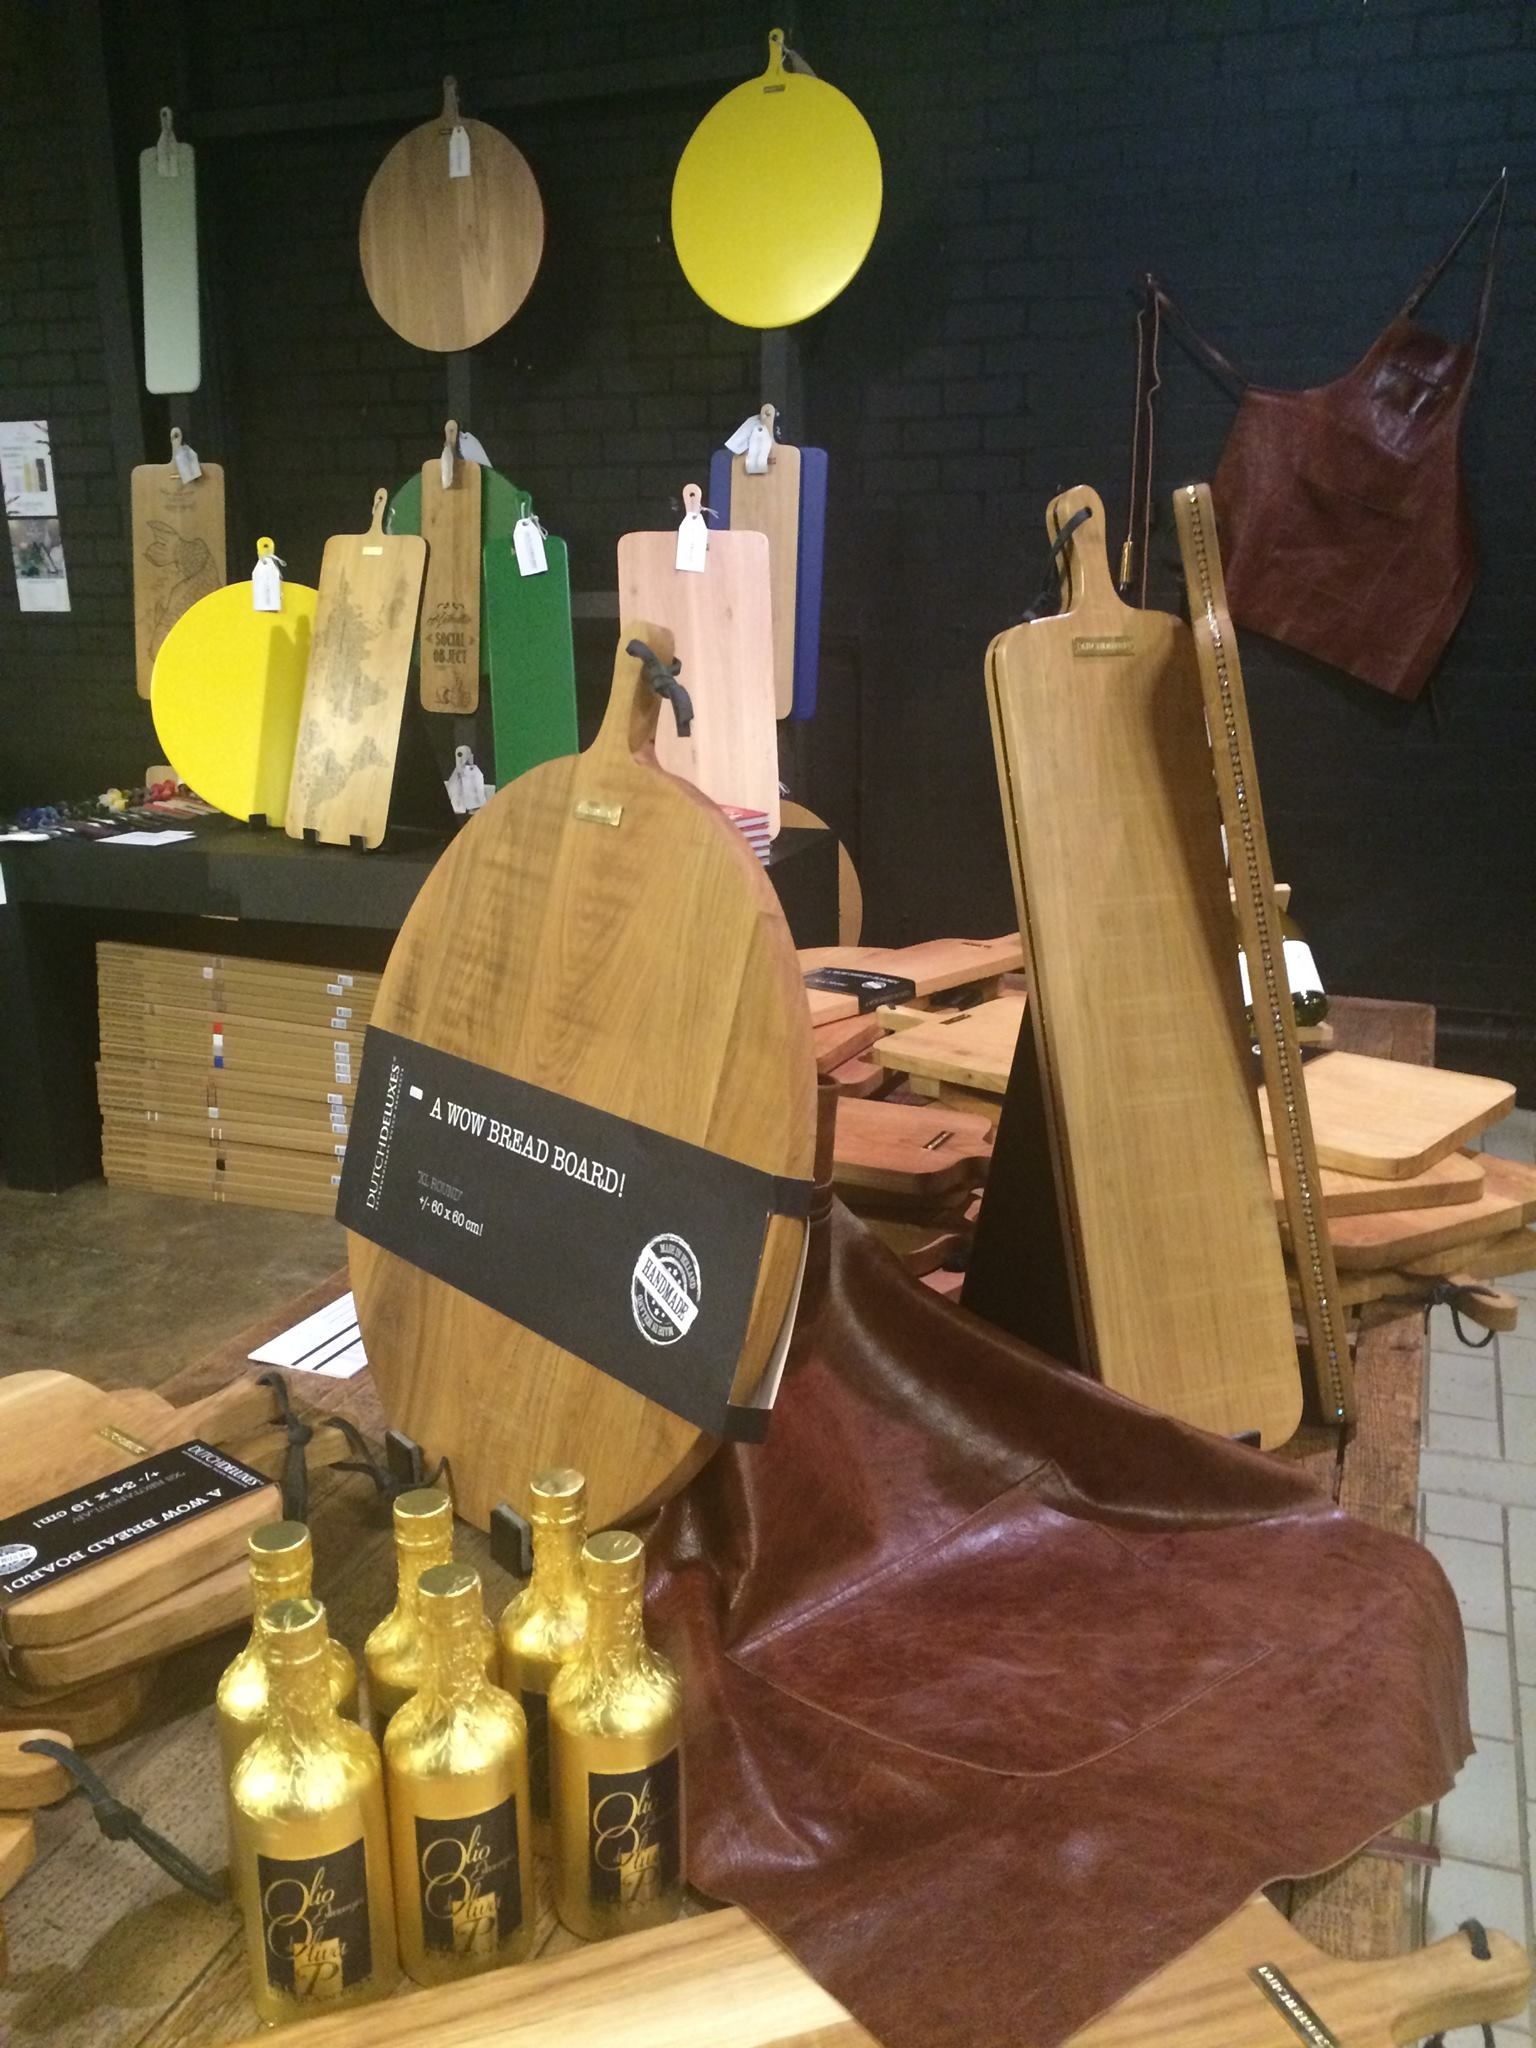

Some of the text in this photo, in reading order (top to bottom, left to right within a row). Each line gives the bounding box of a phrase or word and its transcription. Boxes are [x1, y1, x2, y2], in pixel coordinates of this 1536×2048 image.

[433, 649, 467, 664] OBJECT
[435, 632, 465, 647] SOCIAL
[366, 1063, 400, 1208] DUTCHDELUXES
[430, 1097, 626, 1198] A WOW BREAD BOARD!
[419, 1196, 484, 1237] +/- 60 x 60 cm!
[642, 1257, 689, 1321] HANDMADE
[33, 1471, 160, 1529] +/- 34 x 19 cm!
[3, 1488, 222, 1594] A WOW BREAD BOARD!
[422, 1824, 490, 1886] Olio
[264, 1866, 335, 1927] Olio
